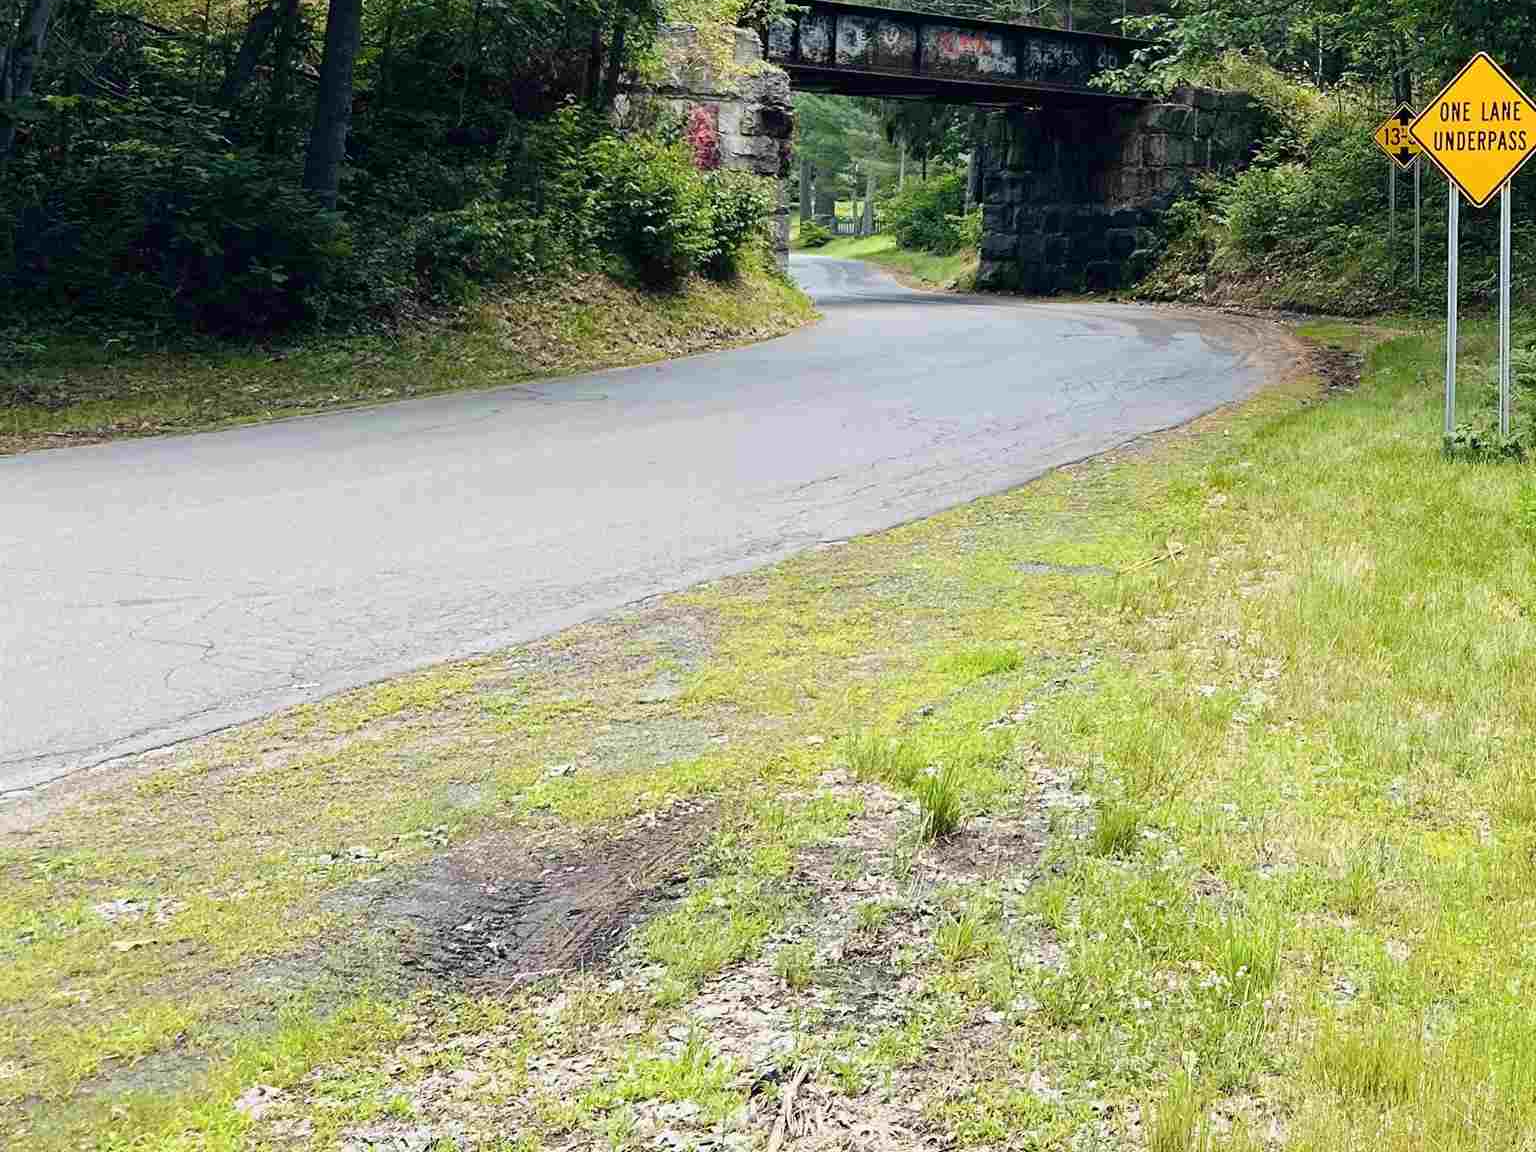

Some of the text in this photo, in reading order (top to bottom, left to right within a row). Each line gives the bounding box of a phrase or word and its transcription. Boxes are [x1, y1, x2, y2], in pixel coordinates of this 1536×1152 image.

[1440, 101, 1521, 121] ONE LANE
[1433, 131, 1527, 151] UNDERPASS
